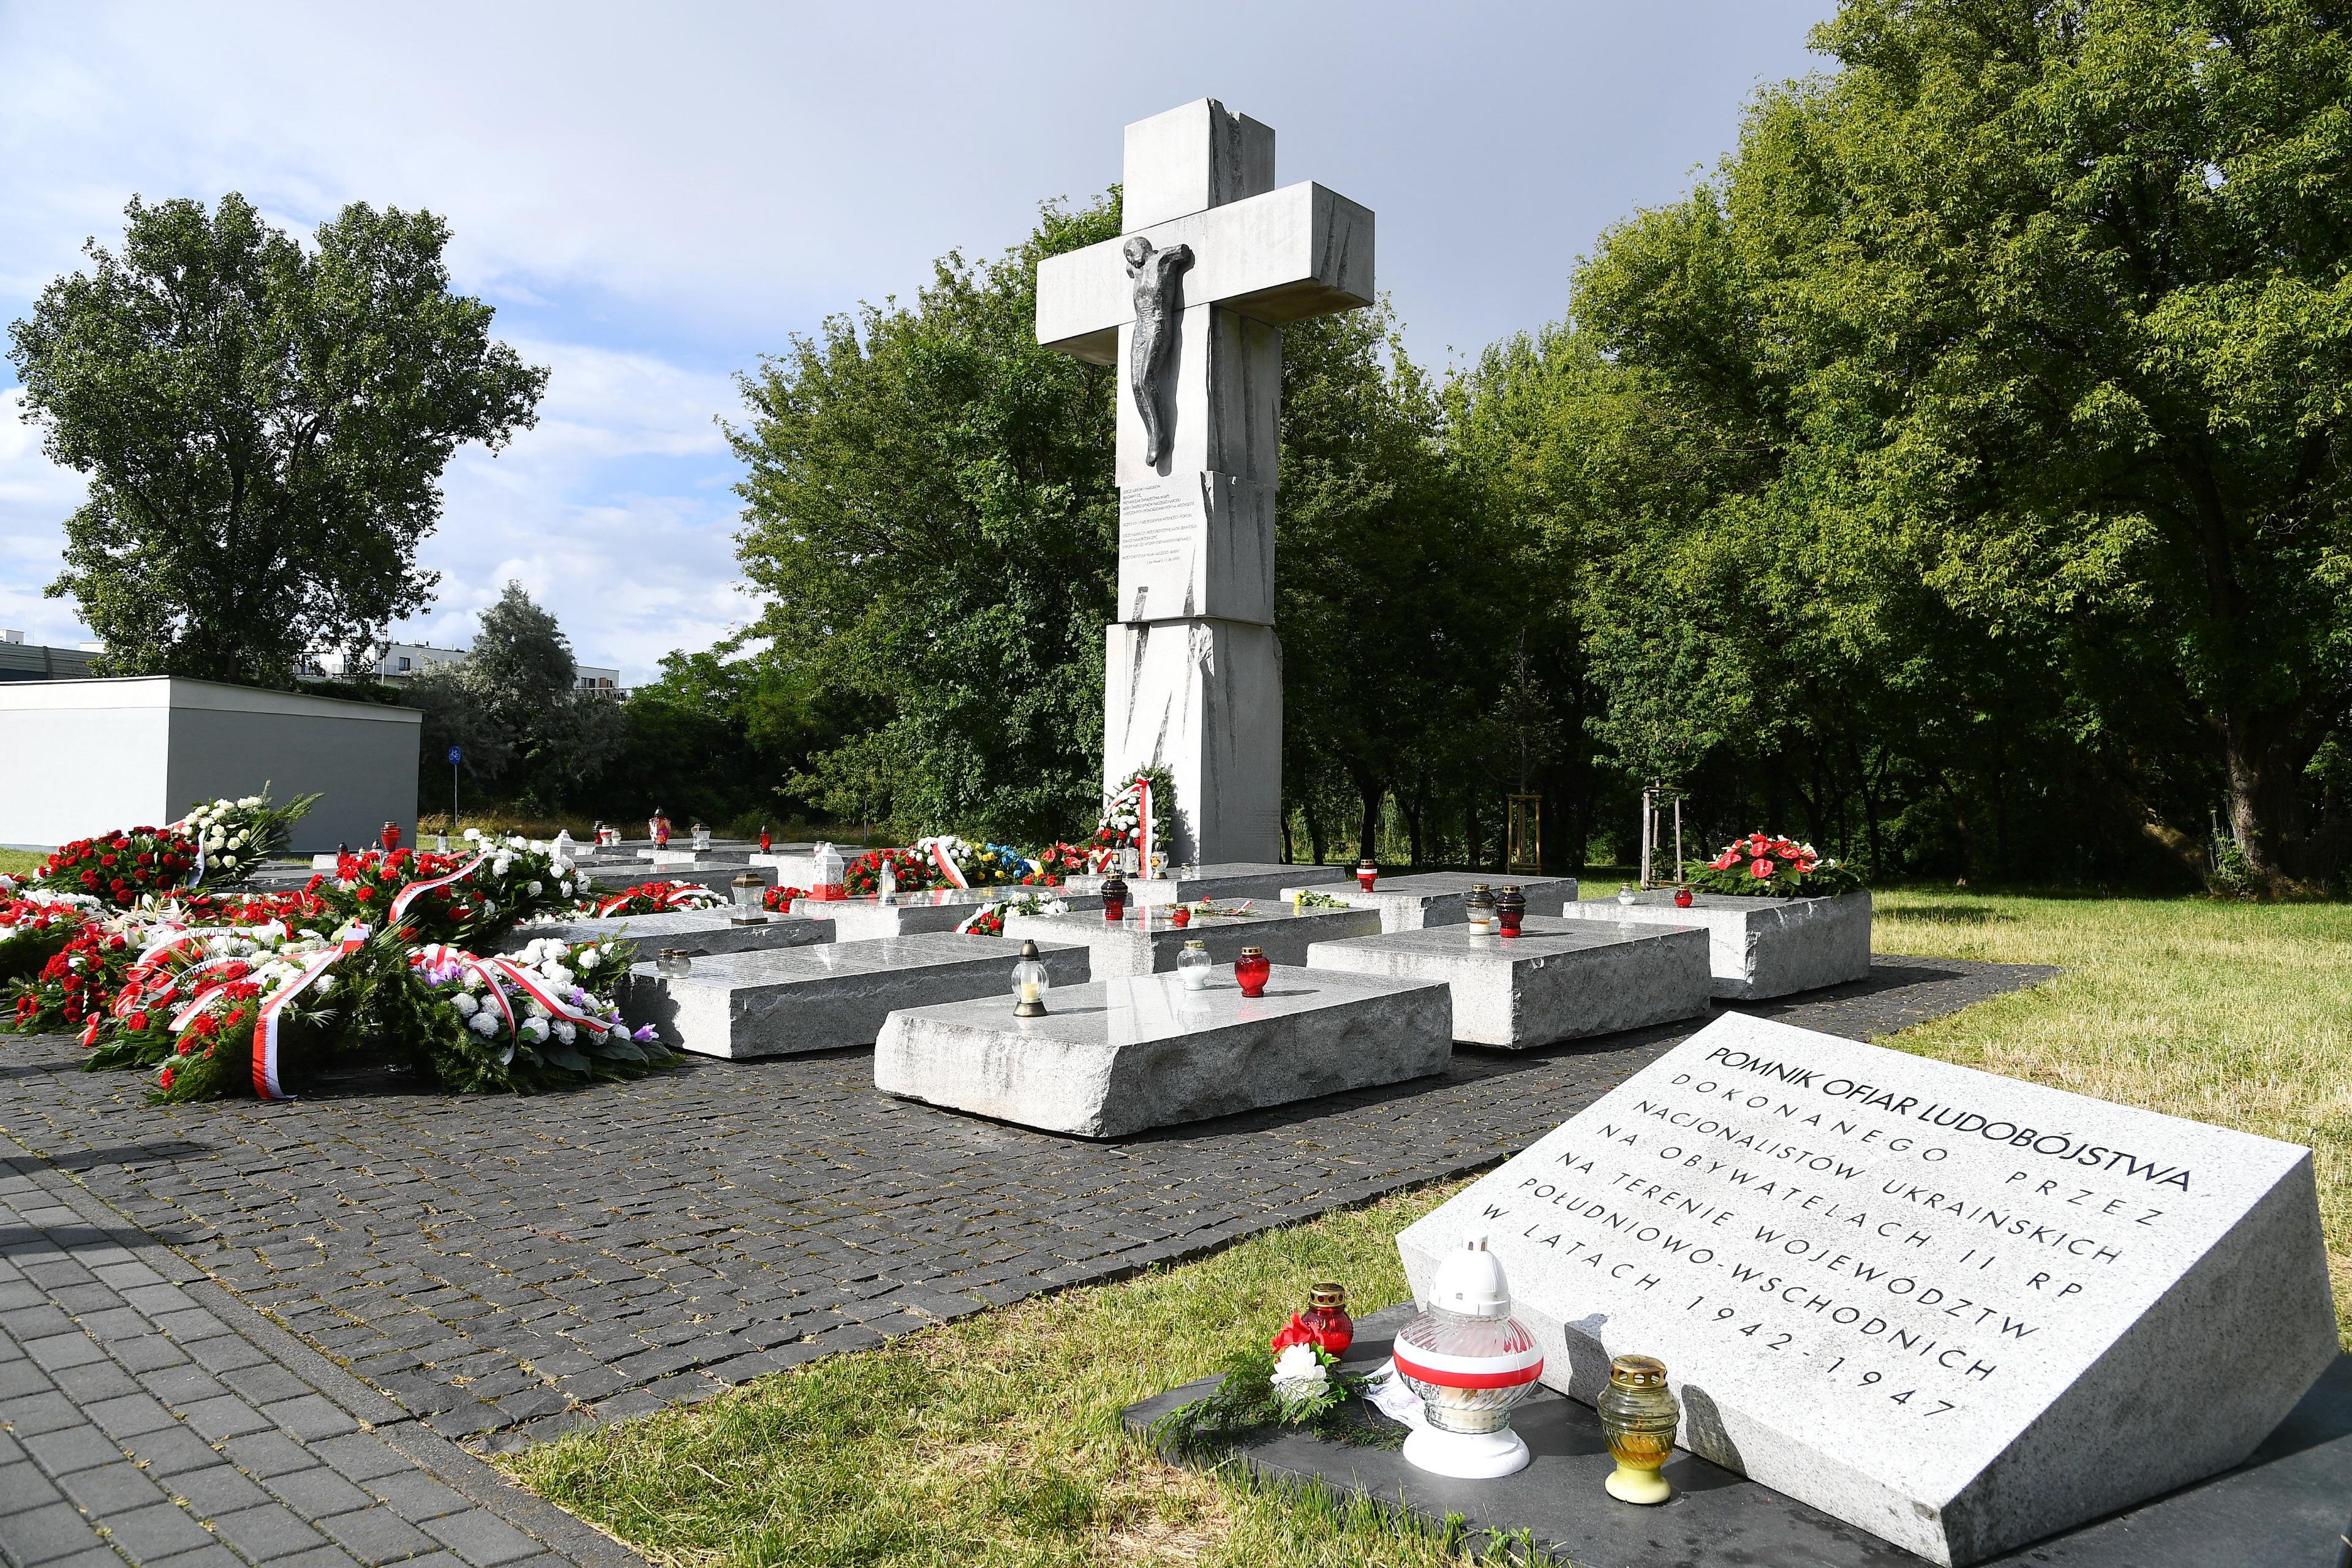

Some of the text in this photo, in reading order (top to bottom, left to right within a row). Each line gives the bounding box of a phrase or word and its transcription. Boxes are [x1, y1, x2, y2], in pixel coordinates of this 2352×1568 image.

[1632, 1099, 2120, 1265] NACJONALISTÓW UKRAIŃSKICH
[1670, 1073, 2165, 1226] DOKONANEGO PRZEZ
[1704, 1046, 2191, 1193] POMNIK OFIAR LUDOBÓJSTWA
[1517, 1177, 1997, 1381] POŁUDNIOWO-WSCHODNICH
[1555, 1152, 2040, 1340] NA TERENIE WOJEWÓDZTW
[1596, 1123, 2083, 1298] NA OBYWATELACH II RP
[1482, 1203, 1956, 1417] W LATACH 1942-1947
